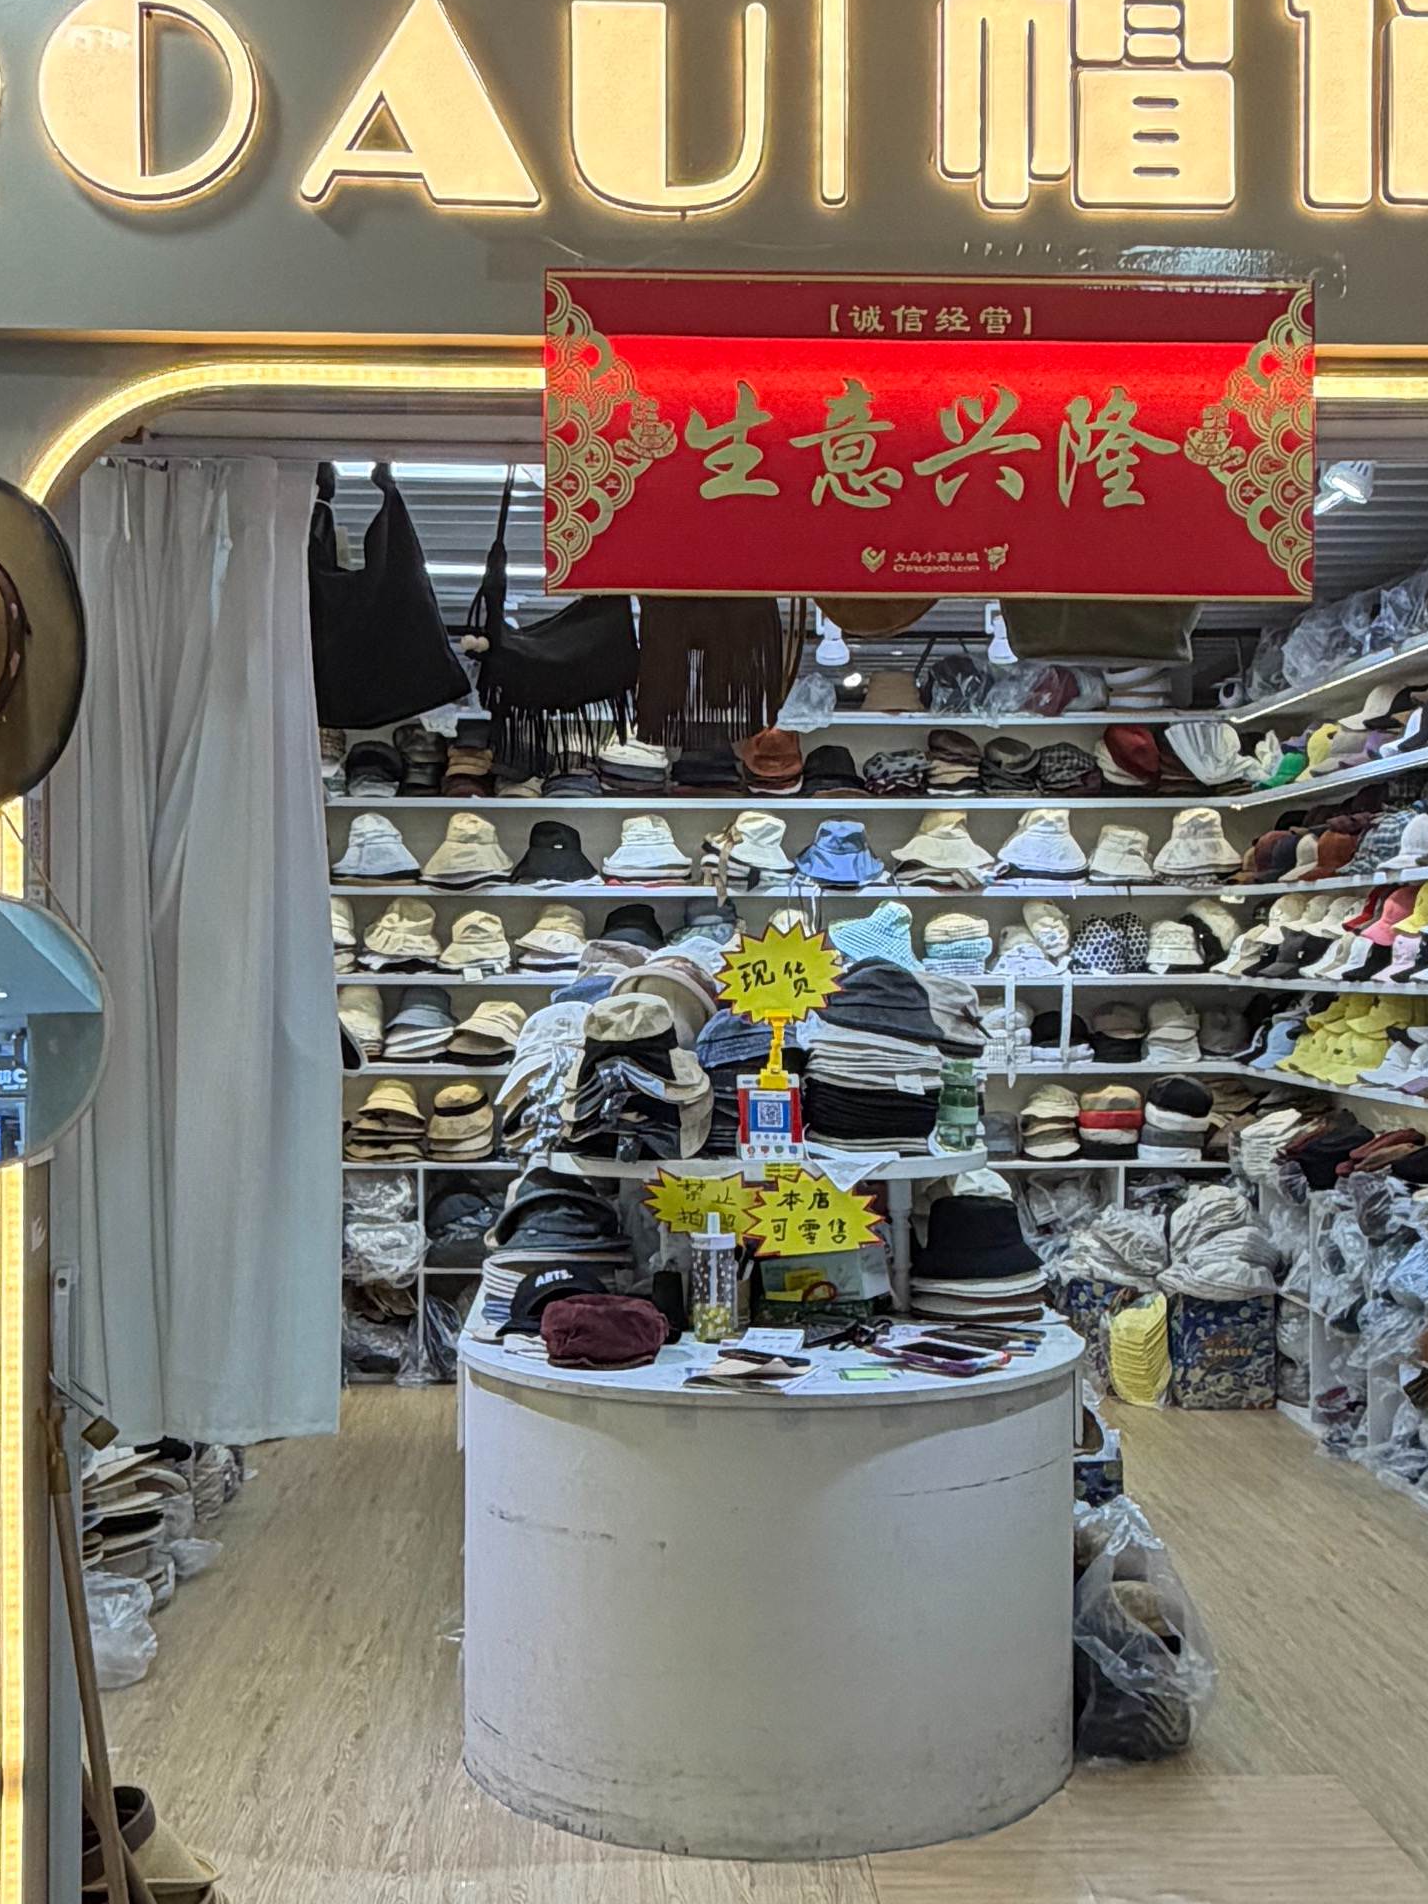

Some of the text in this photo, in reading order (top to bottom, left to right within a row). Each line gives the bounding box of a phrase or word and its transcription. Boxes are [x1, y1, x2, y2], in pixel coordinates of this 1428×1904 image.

[684, 379, 1179, 509] 生意兴隆
[737, 959, 817, 998] 现货
[677, 1180, 737, 1206] 禁止
[776, 1188, 830, 1211] 本店
[771, 1218, 848, 1245] 可零售
